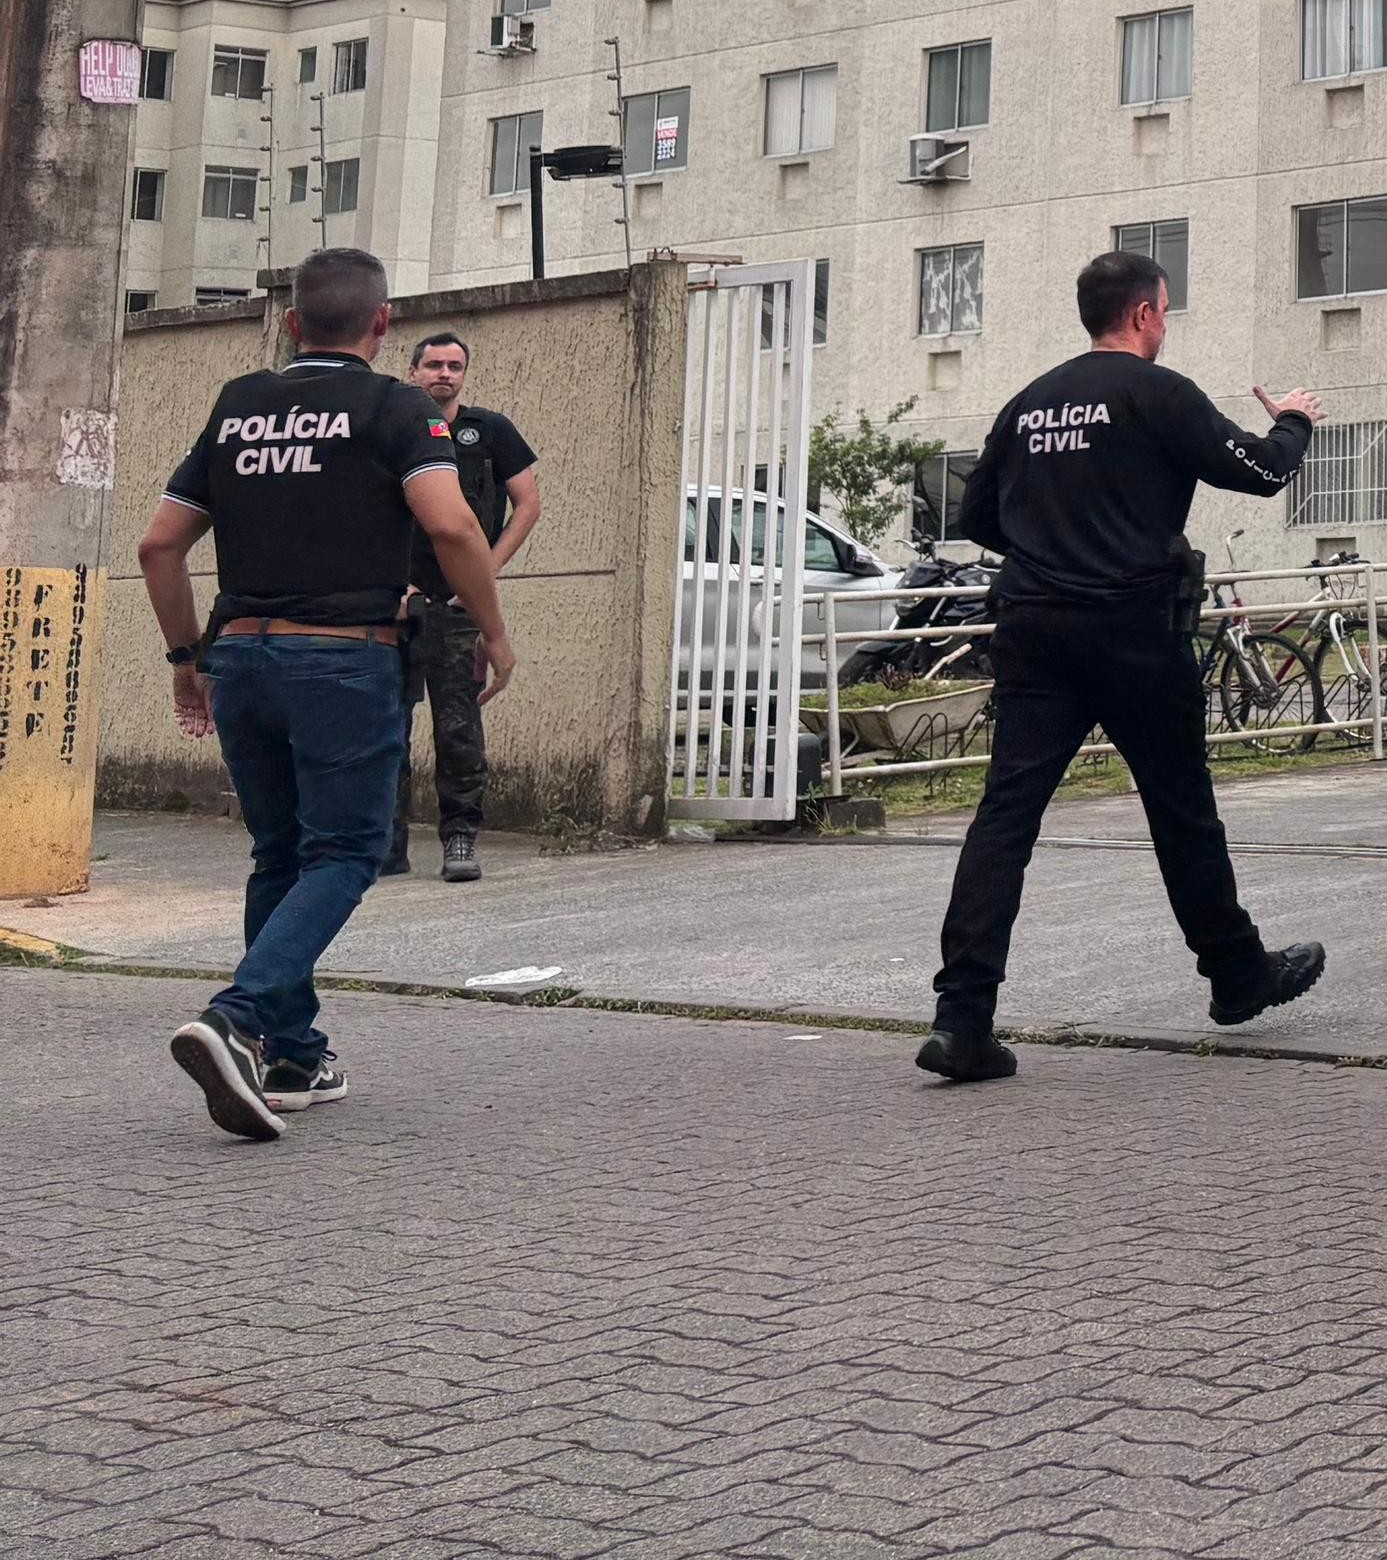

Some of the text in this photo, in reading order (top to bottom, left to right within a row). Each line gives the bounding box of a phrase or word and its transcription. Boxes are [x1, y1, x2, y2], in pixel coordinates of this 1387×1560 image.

[80, 40, 113, 75] HELP
[217, 405, 351, 443] POLÍCIA
[1017, 403, 1110, 434] POLÍCIA
[1029, 429, 1090, 454] CIVIL
[235, 446, 322, 475] CIVIL
